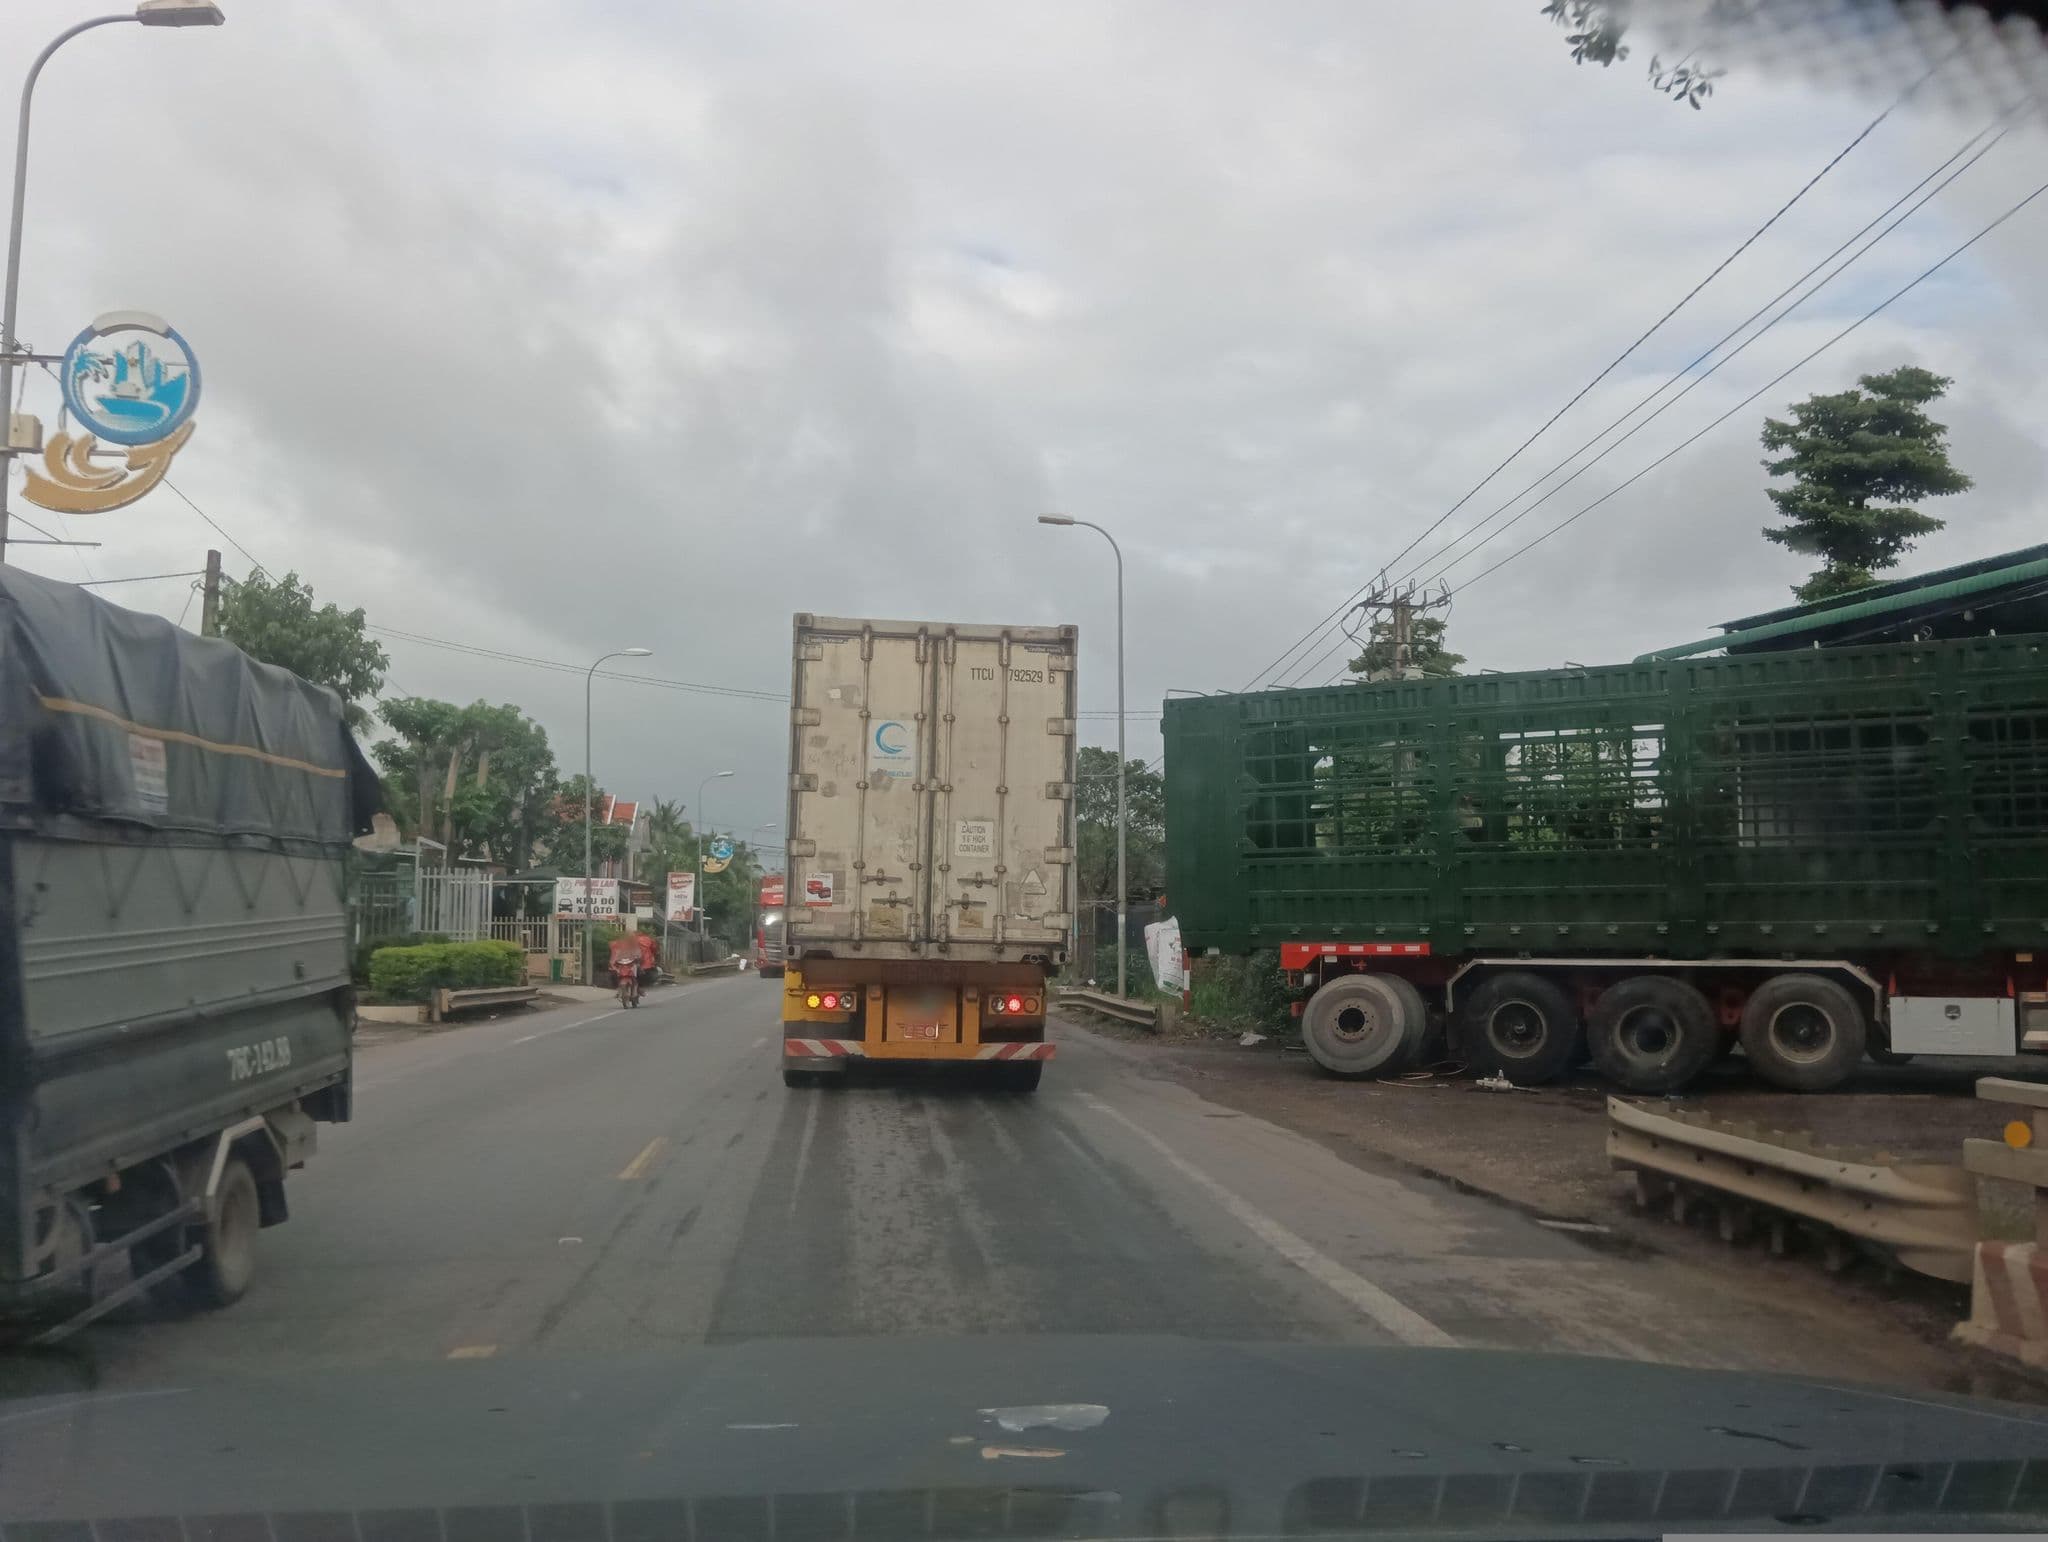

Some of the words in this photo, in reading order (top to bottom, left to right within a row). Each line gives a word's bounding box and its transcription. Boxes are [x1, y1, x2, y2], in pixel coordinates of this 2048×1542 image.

[970, 667, 994, 681] TTCU
[1008, 668, 1043, 683] 792529
[1048, 671, 1055, 684] 6
